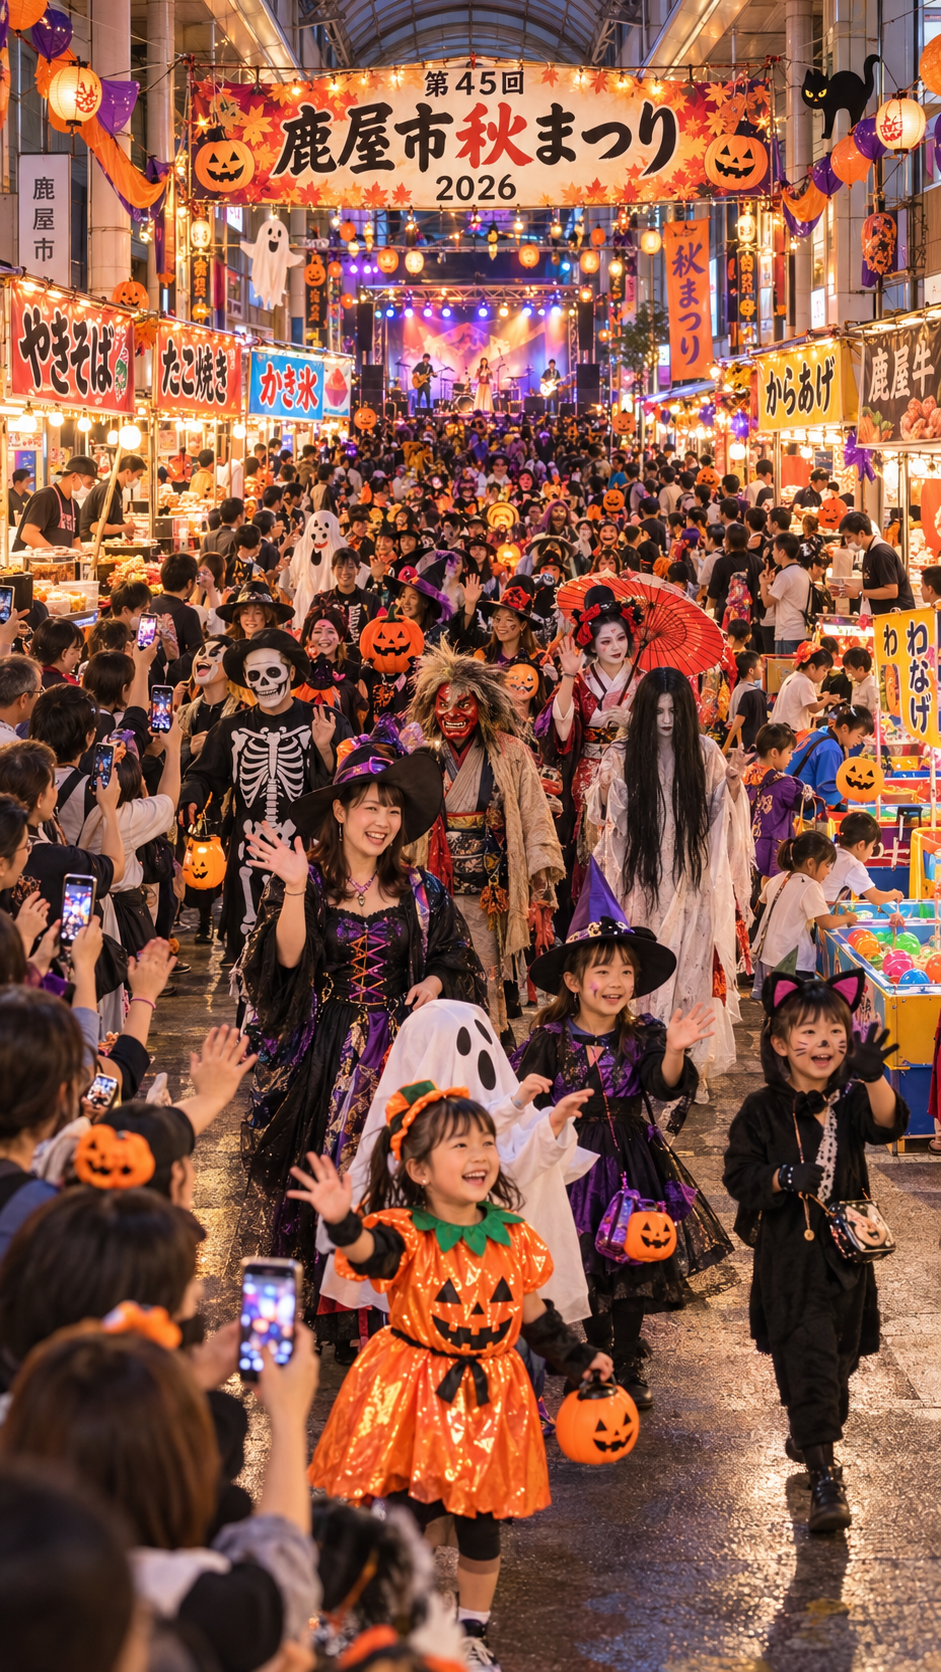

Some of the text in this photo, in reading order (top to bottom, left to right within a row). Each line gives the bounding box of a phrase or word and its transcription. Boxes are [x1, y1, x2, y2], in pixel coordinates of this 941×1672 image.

[424, 70, 524, 97] 第45回
[272, 102, 677, 177] 鹿屋市秋まつり
[33, 176, 55, 262] 鹿屋市
[436, 174, 516, 201] 2026
[672, 242, 706, 366] 秋まつり
[19, 306, 115, 397] やきそば
[162, 339, 228, 404] たこ焼き
[868, 340, 935, 403] 鹿屋牛
[260, 362, 319, 411] かき氷
[766, 355, 836, 417] からあげ
[883, 623, 898, 657] わ
[906, 620, 932, 734] わなげ
